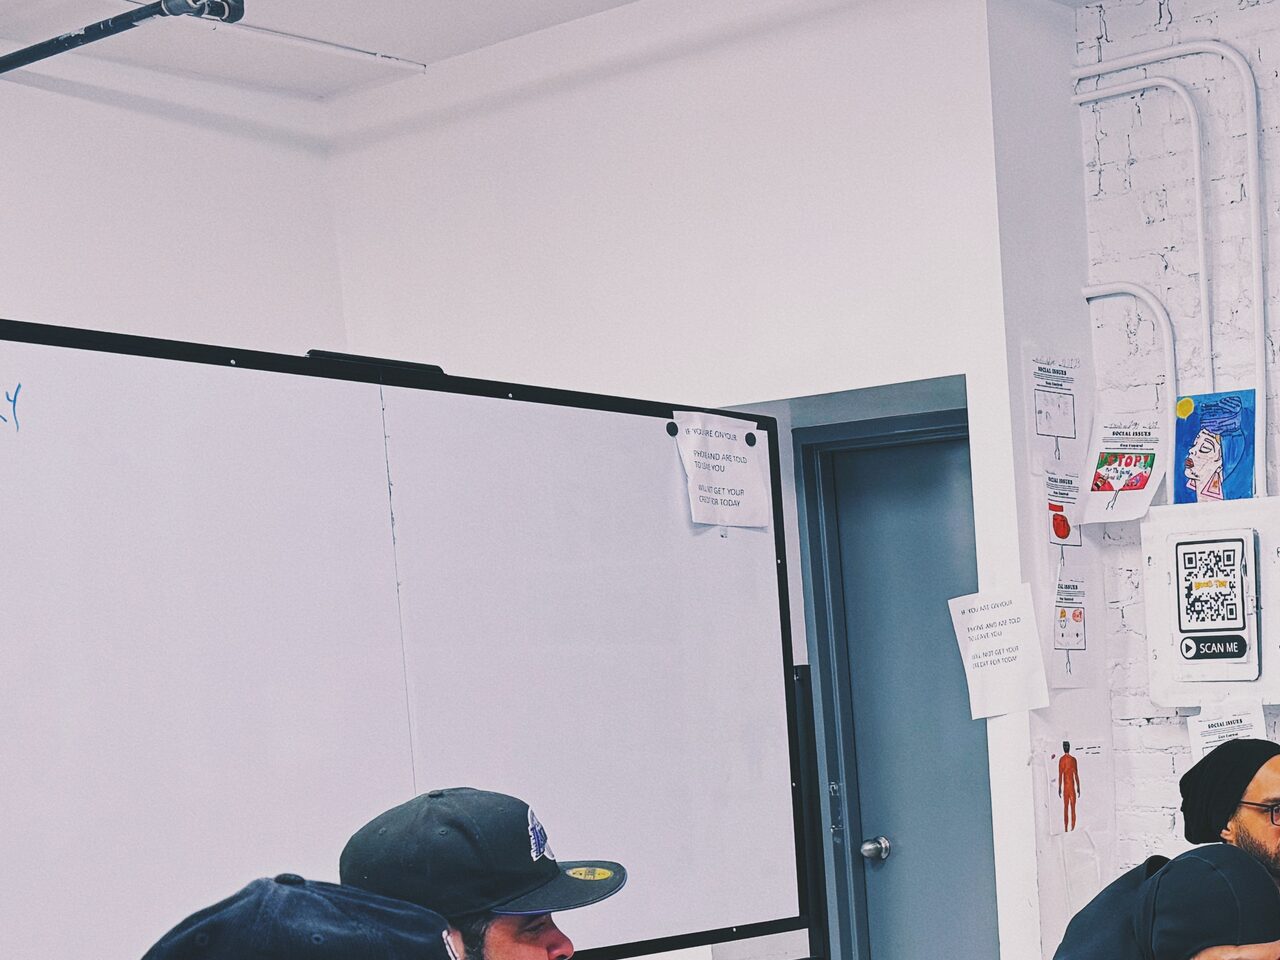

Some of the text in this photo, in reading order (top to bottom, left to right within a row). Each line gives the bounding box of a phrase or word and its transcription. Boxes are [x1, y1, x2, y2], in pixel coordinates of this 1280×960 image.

[711, 463, 725, 473] YOU
[713, 487, 725, 495] GET
[726, 488, 745, 496] YOUR
[720, 499, 741, 507] TODAY
[1199, 642, 1238, 654] SCAN ME
[1207, 718, 1243, 729] SOCIAL ISSUES
